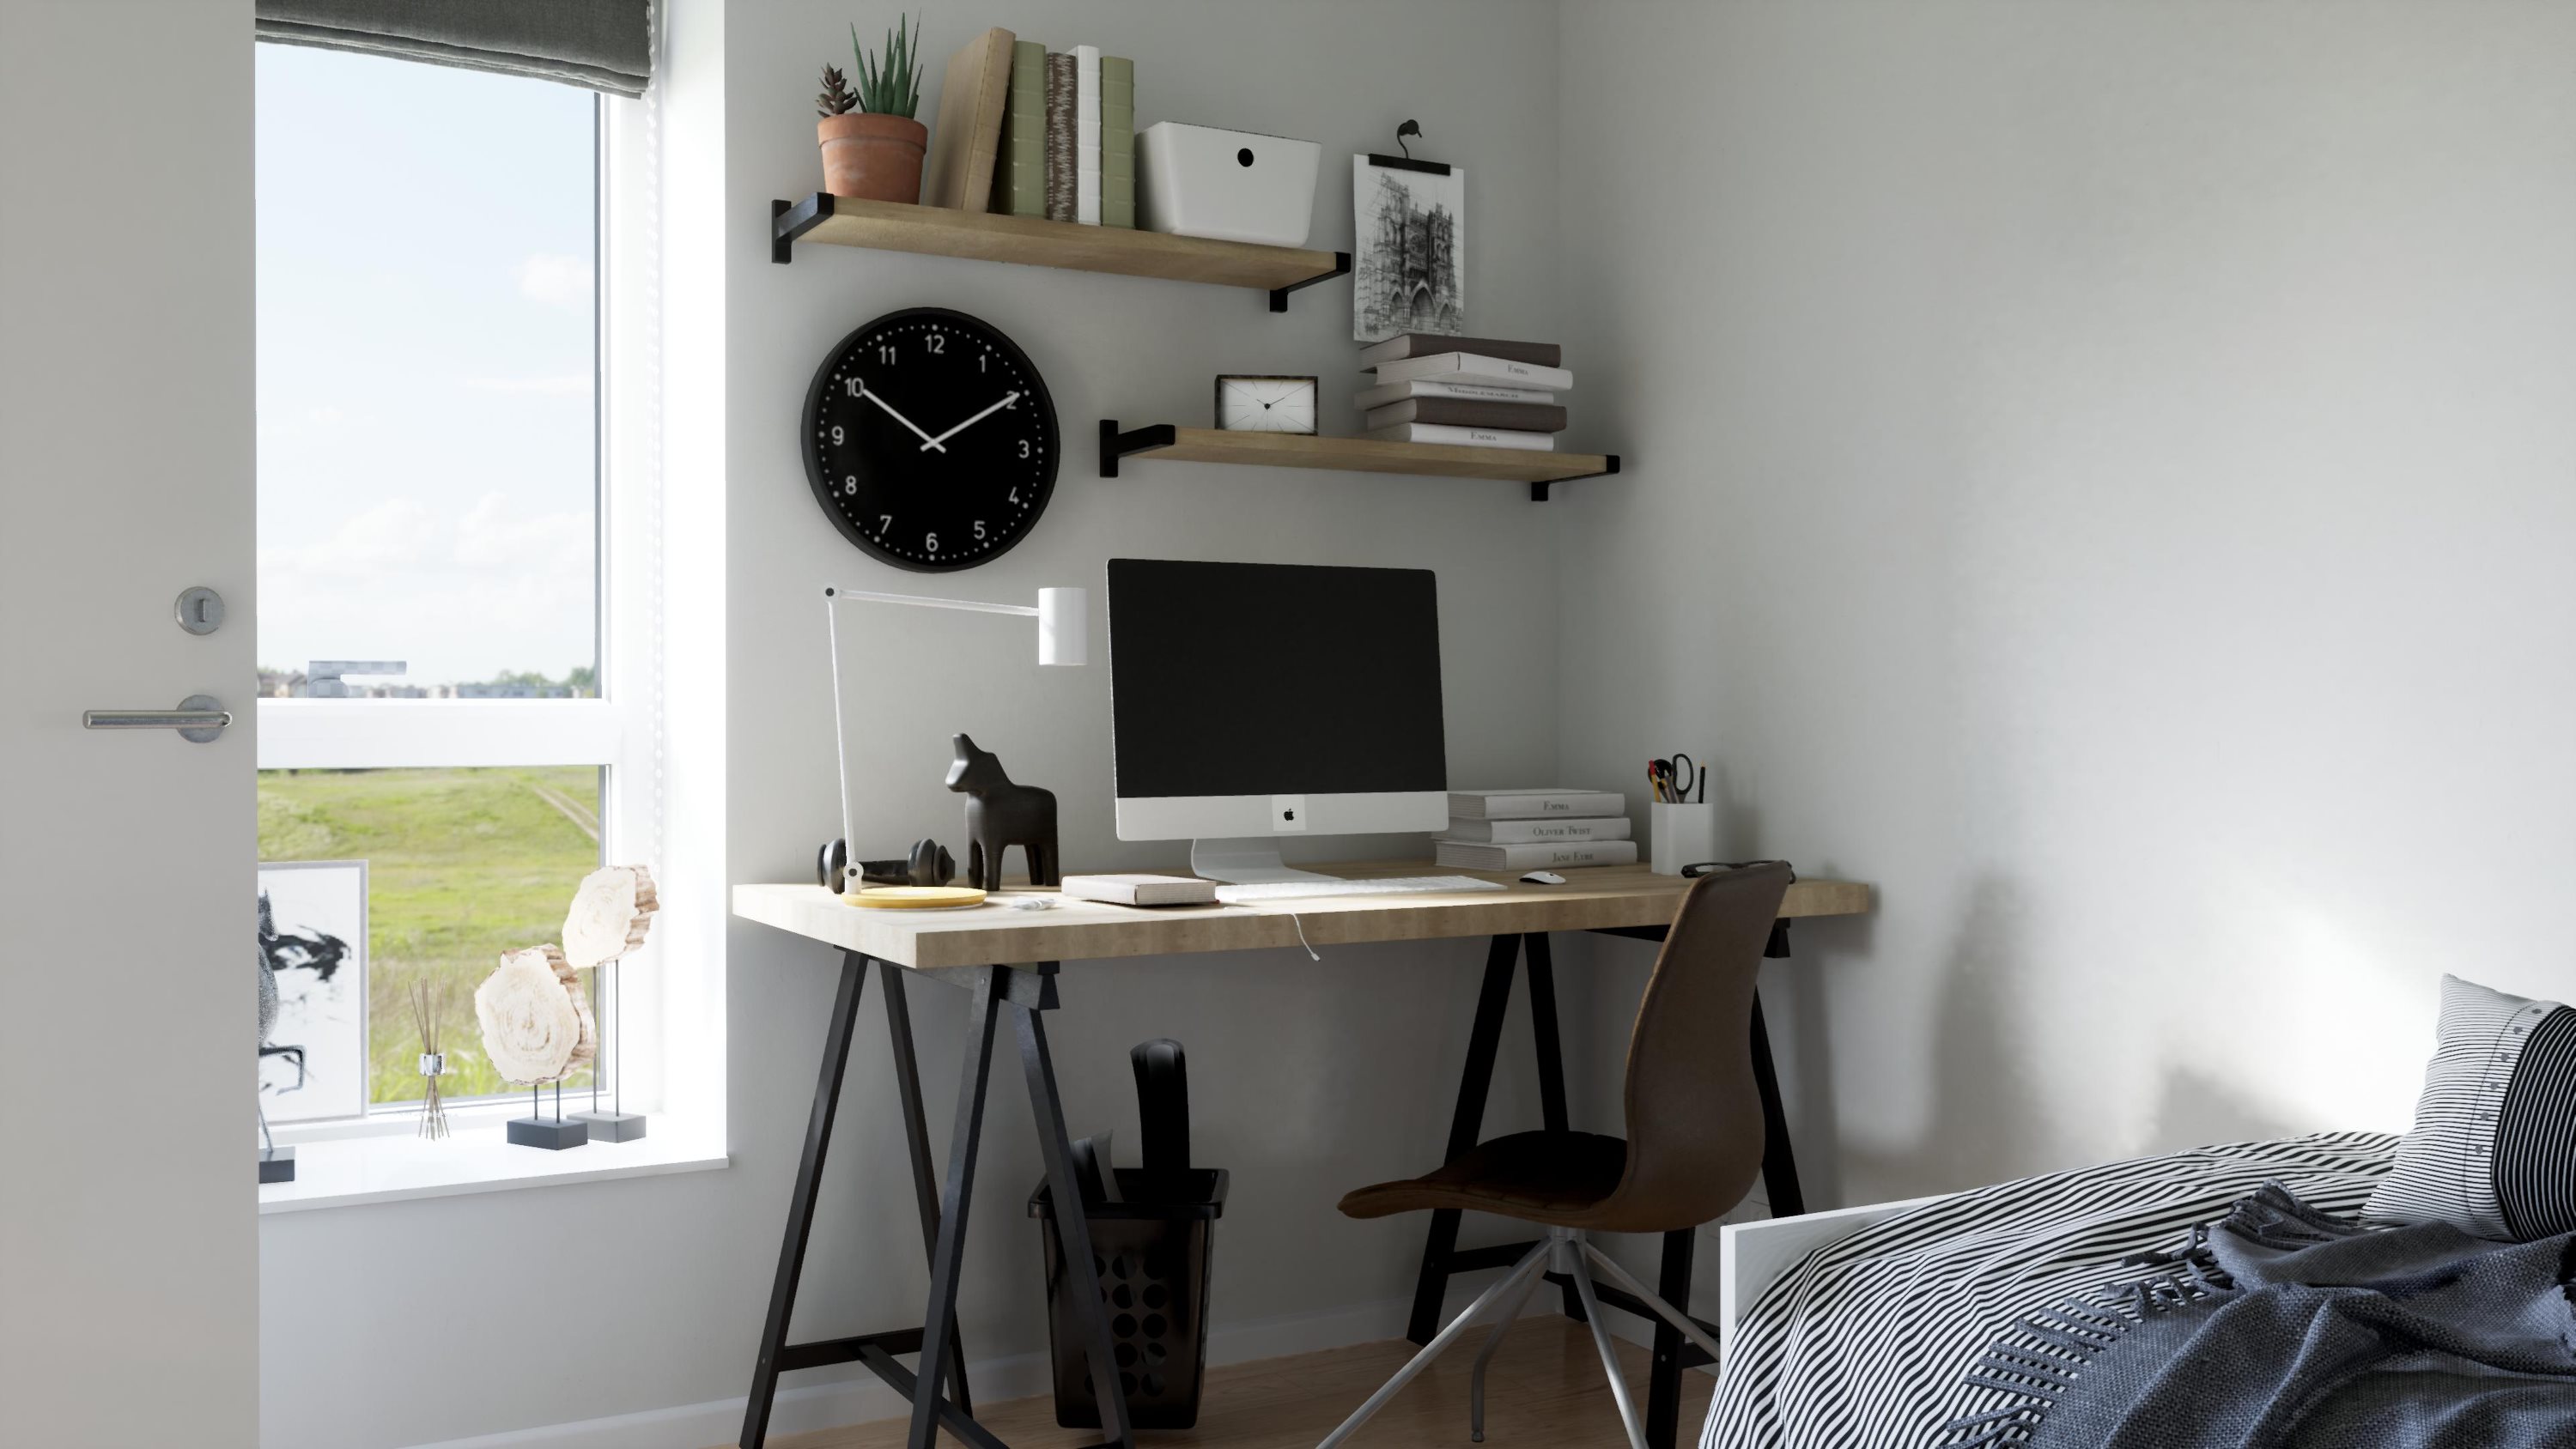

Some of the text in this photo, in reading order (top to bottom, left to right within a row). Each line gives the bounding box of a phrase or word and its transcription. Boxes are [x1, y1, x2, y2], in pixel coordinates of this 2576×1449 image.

[925, 334, 945, 354] 12
[878, 346, 896, 365] 11
[979, 355, 986, 373] 1
[1507, 364, 1529, 376] EMMA
[844, 378, 864, 397] 10
[831, 426, 844, 446] 9
[1470, 431, 1498, 442] EMMA
[1018, 440, 1030, 458] 3
[845, 475, 857, 495] 8
[1008, 486, 1020, 505] 4
[879, 515, 892, 534] 7
[974, 520, 986, 540] 5
[926, 532, 939, 552] 6
[1543, 800, 1571, 811] EMMA
[1532, 825, 1592, 837] OLIVER TWIST
